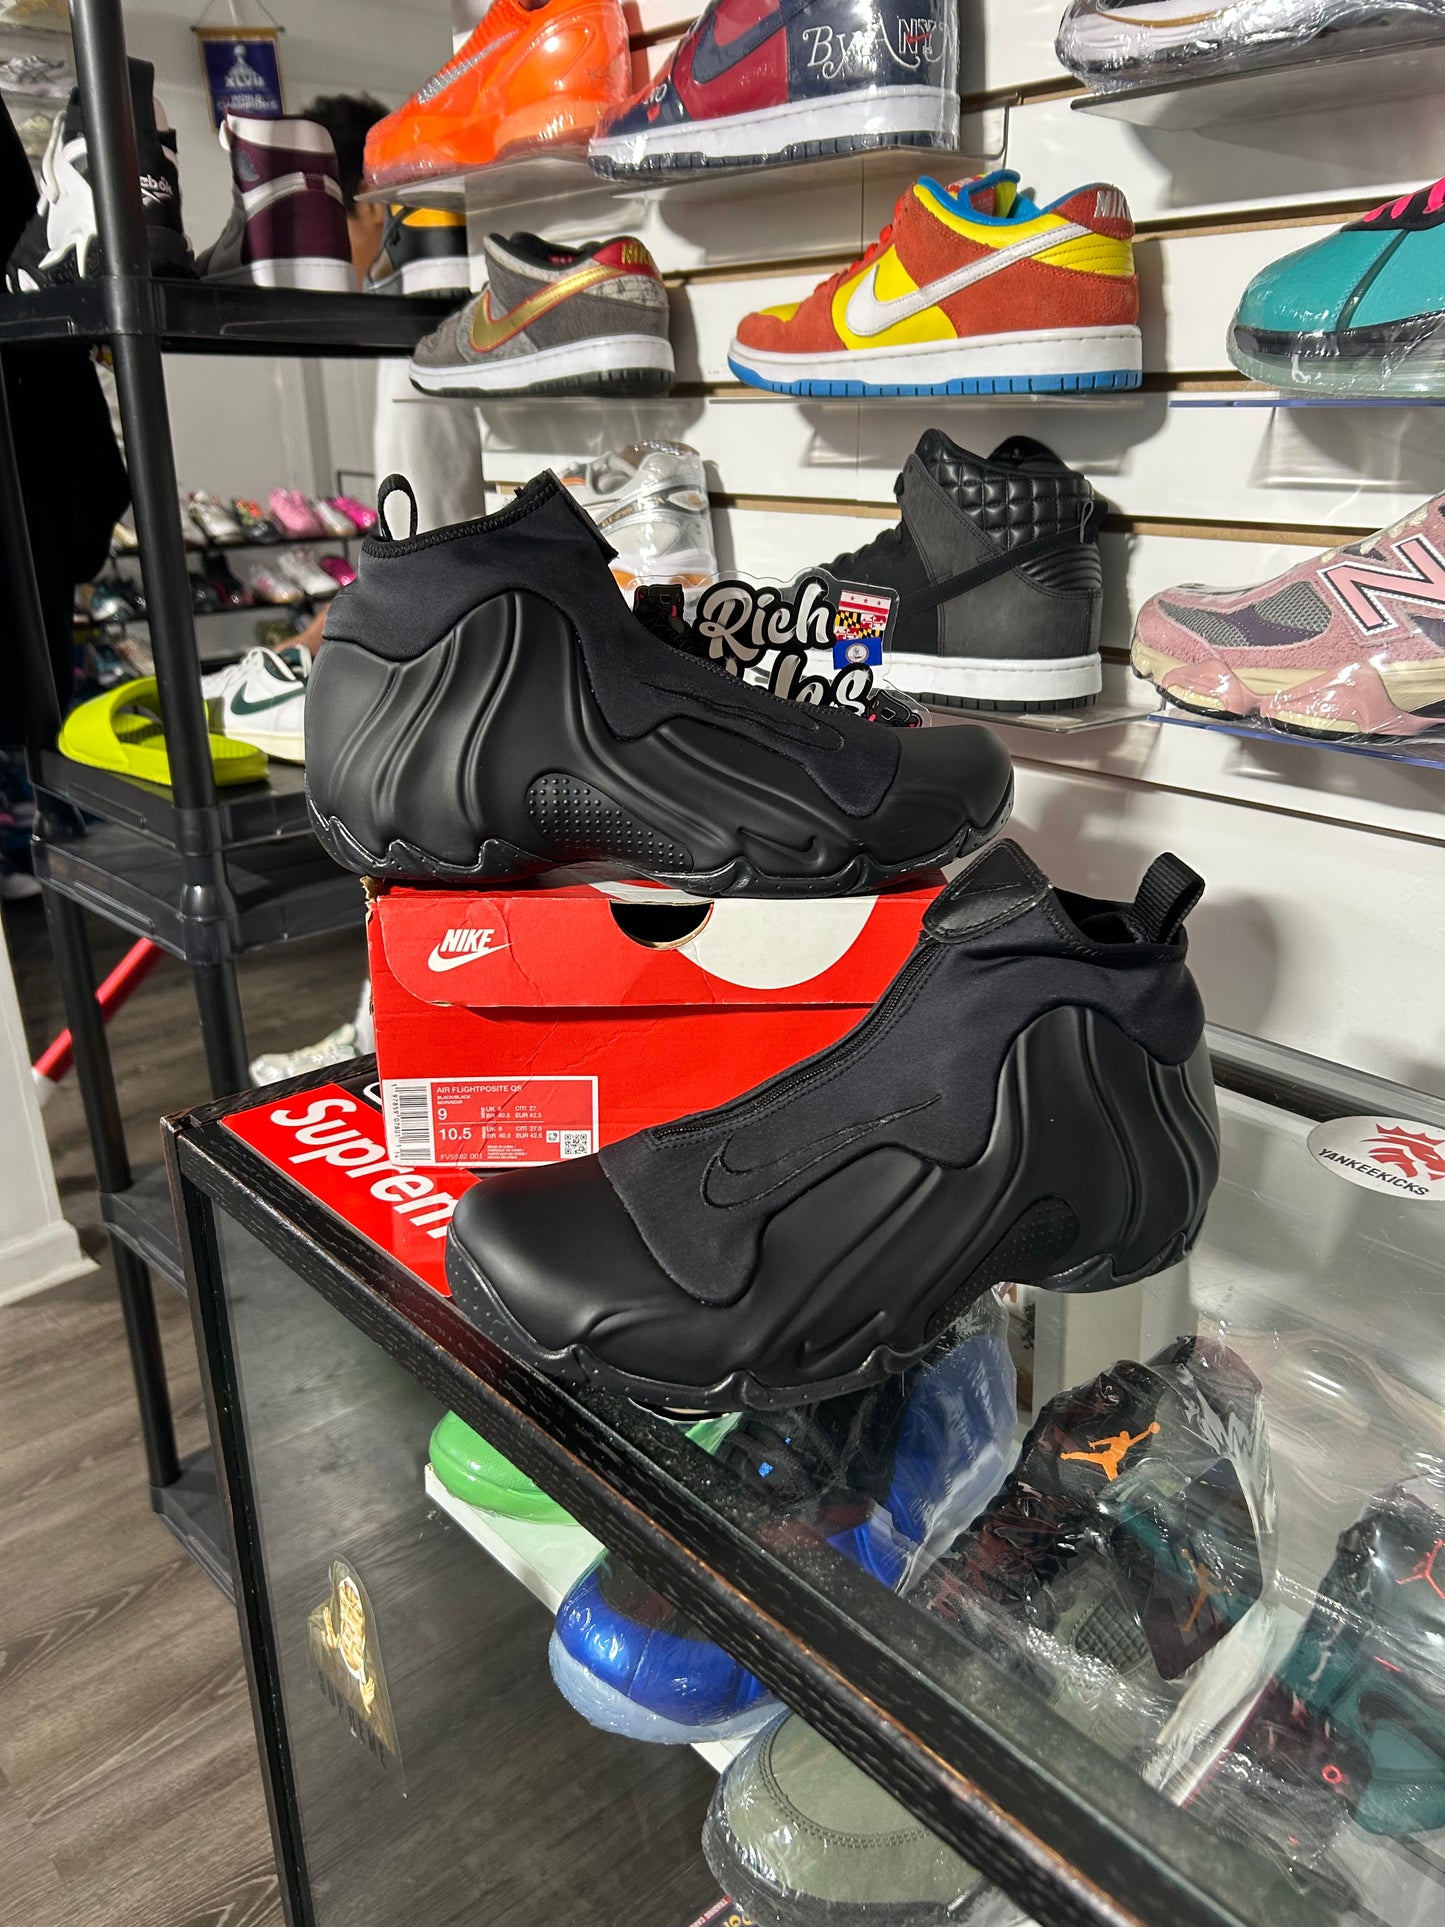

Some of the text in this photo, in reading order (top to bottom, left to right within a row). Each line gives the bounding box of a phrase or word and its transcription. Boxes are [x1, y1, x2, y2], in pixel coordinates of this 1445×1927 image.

[700, 582, 830, 662] Rich
[440, 928, 495, 953] NIKE
[451, 1085, 509, 1093] FLIGHTPOSITE
[437, 1108, 448, 1120] 9
[439, 1127, 472, 1140] 10.5
[269, 1098, 459, 1239] Suprem
[1318, 1148, 1430, 1196] YANKEEKICKS
